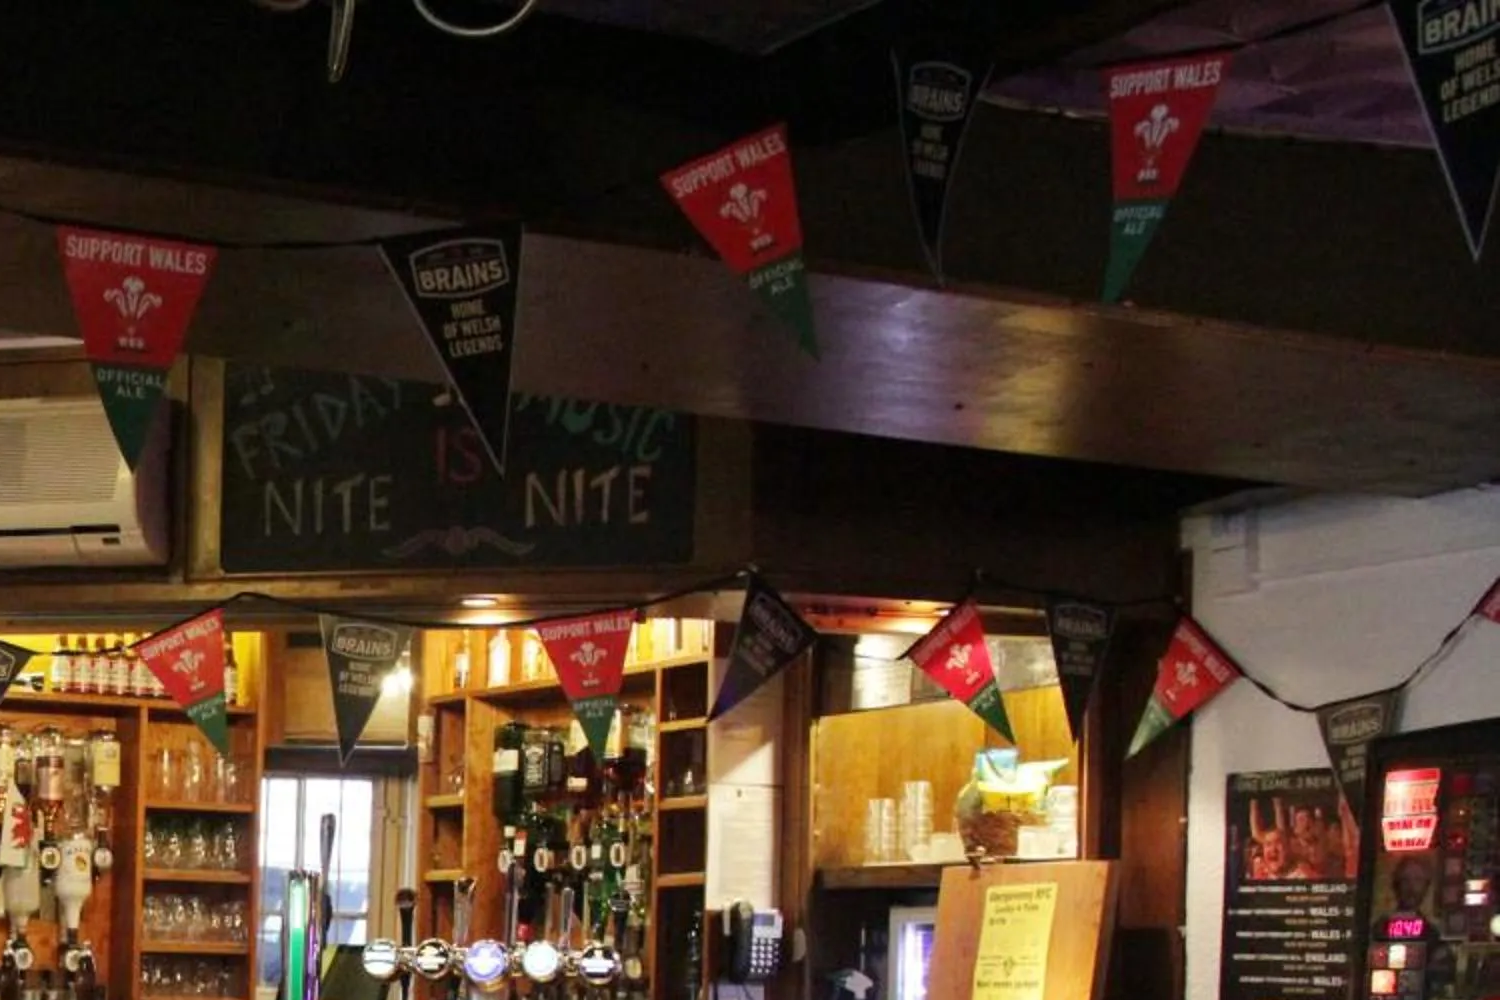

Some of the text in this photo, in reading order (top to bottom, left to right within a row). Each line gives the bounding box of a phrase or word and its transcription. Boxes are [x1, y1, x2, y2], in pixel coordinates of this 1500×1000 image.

[1425, 0, 1500, 44] BRAI
[1109, 60, 1224, 99] SUPPORT WALES
[1462, 57, 1500, 92] WELS
[1443, 84, 1500, 123] LEGEND
[671, 131, 788, 199] SUPPORT WALES
[65, 235, 207, 275] SUPPORT WALES
[418, 258, 504, 292] BRAINS
[97, 367, 163, 387] OFFICIAL
[115, 383, 147, 400] ALE
[434, 425, 483, 485] IS
[263, 472, 394, 538] NITE
[524, 464, 653, 530] NITE
[336, 635, 392, 657] BRAINS
